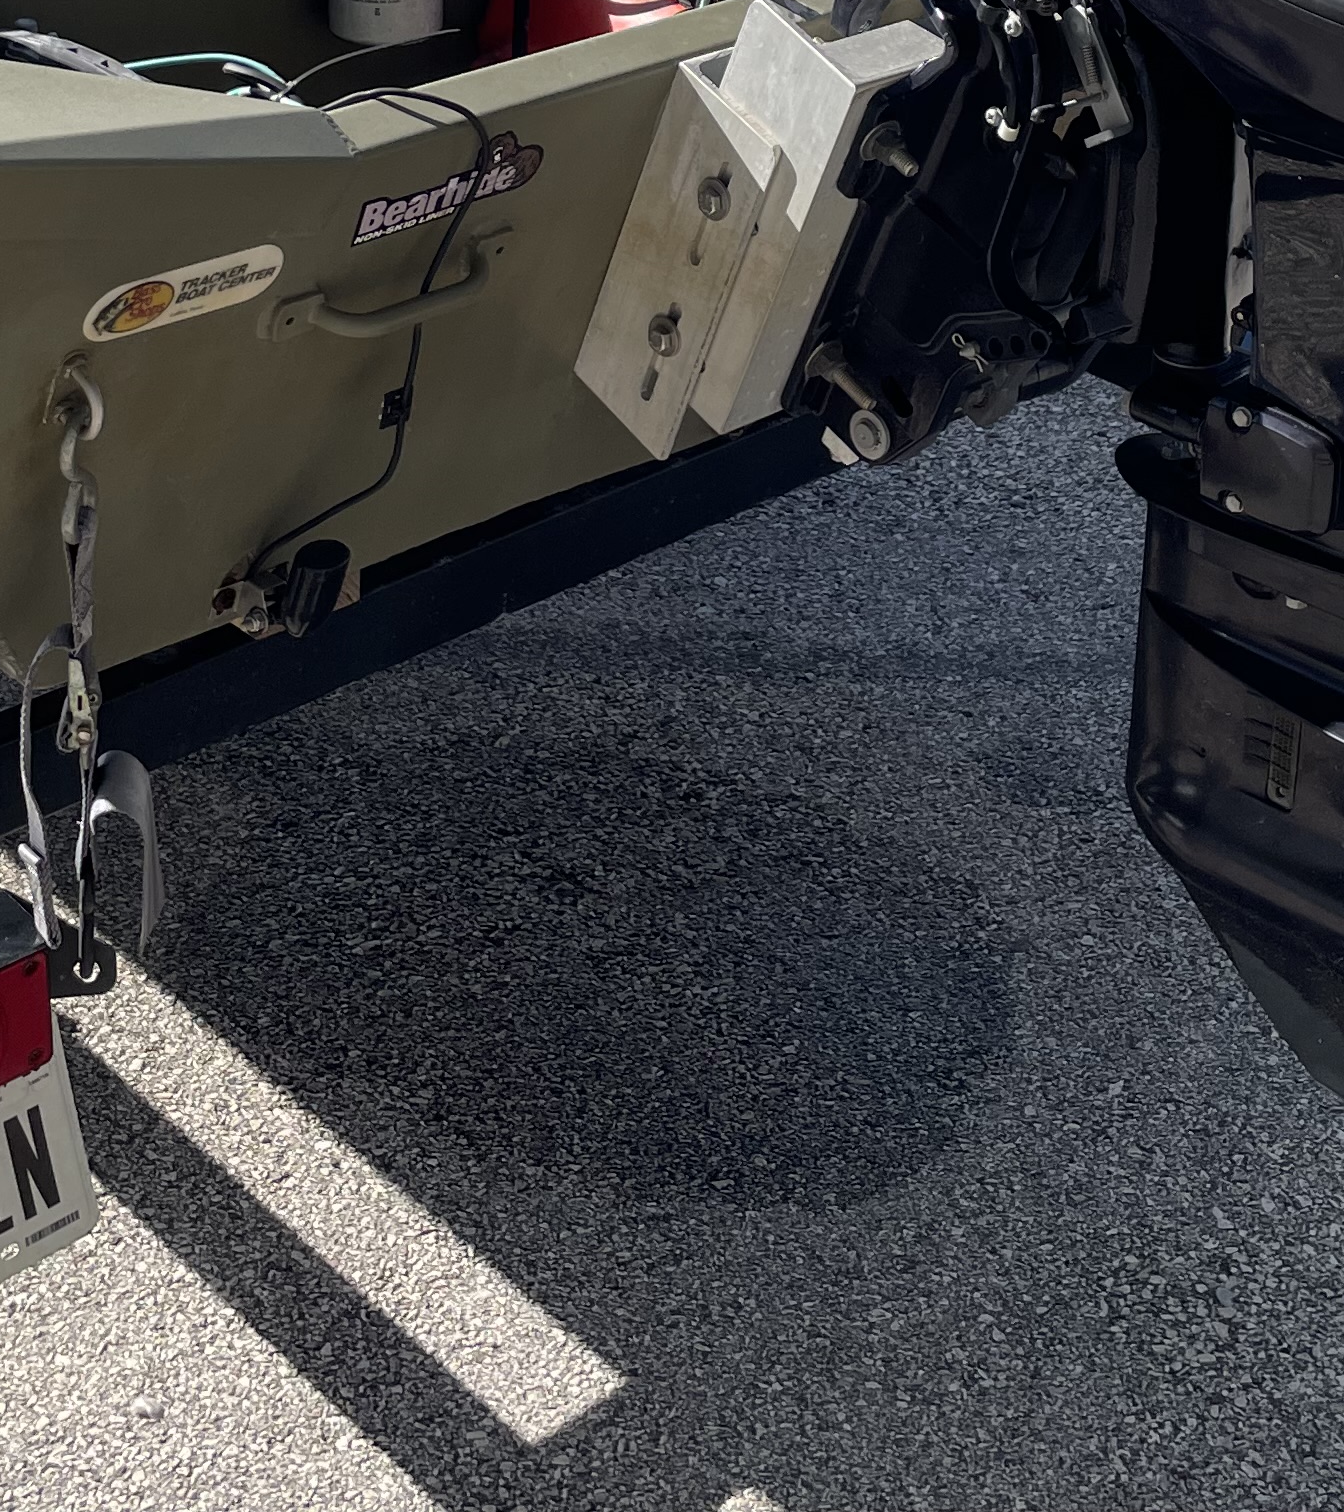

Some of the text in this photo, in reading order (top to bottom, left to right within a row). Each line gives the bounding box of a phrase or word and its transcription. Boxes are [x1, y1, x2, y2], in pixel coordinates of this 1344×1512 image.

[354, 206, 455, 244] NON-SKID LINER
[175, 266, 276, 304] BOAT CENTER
[181, 263, 249, 291] TRACKER
